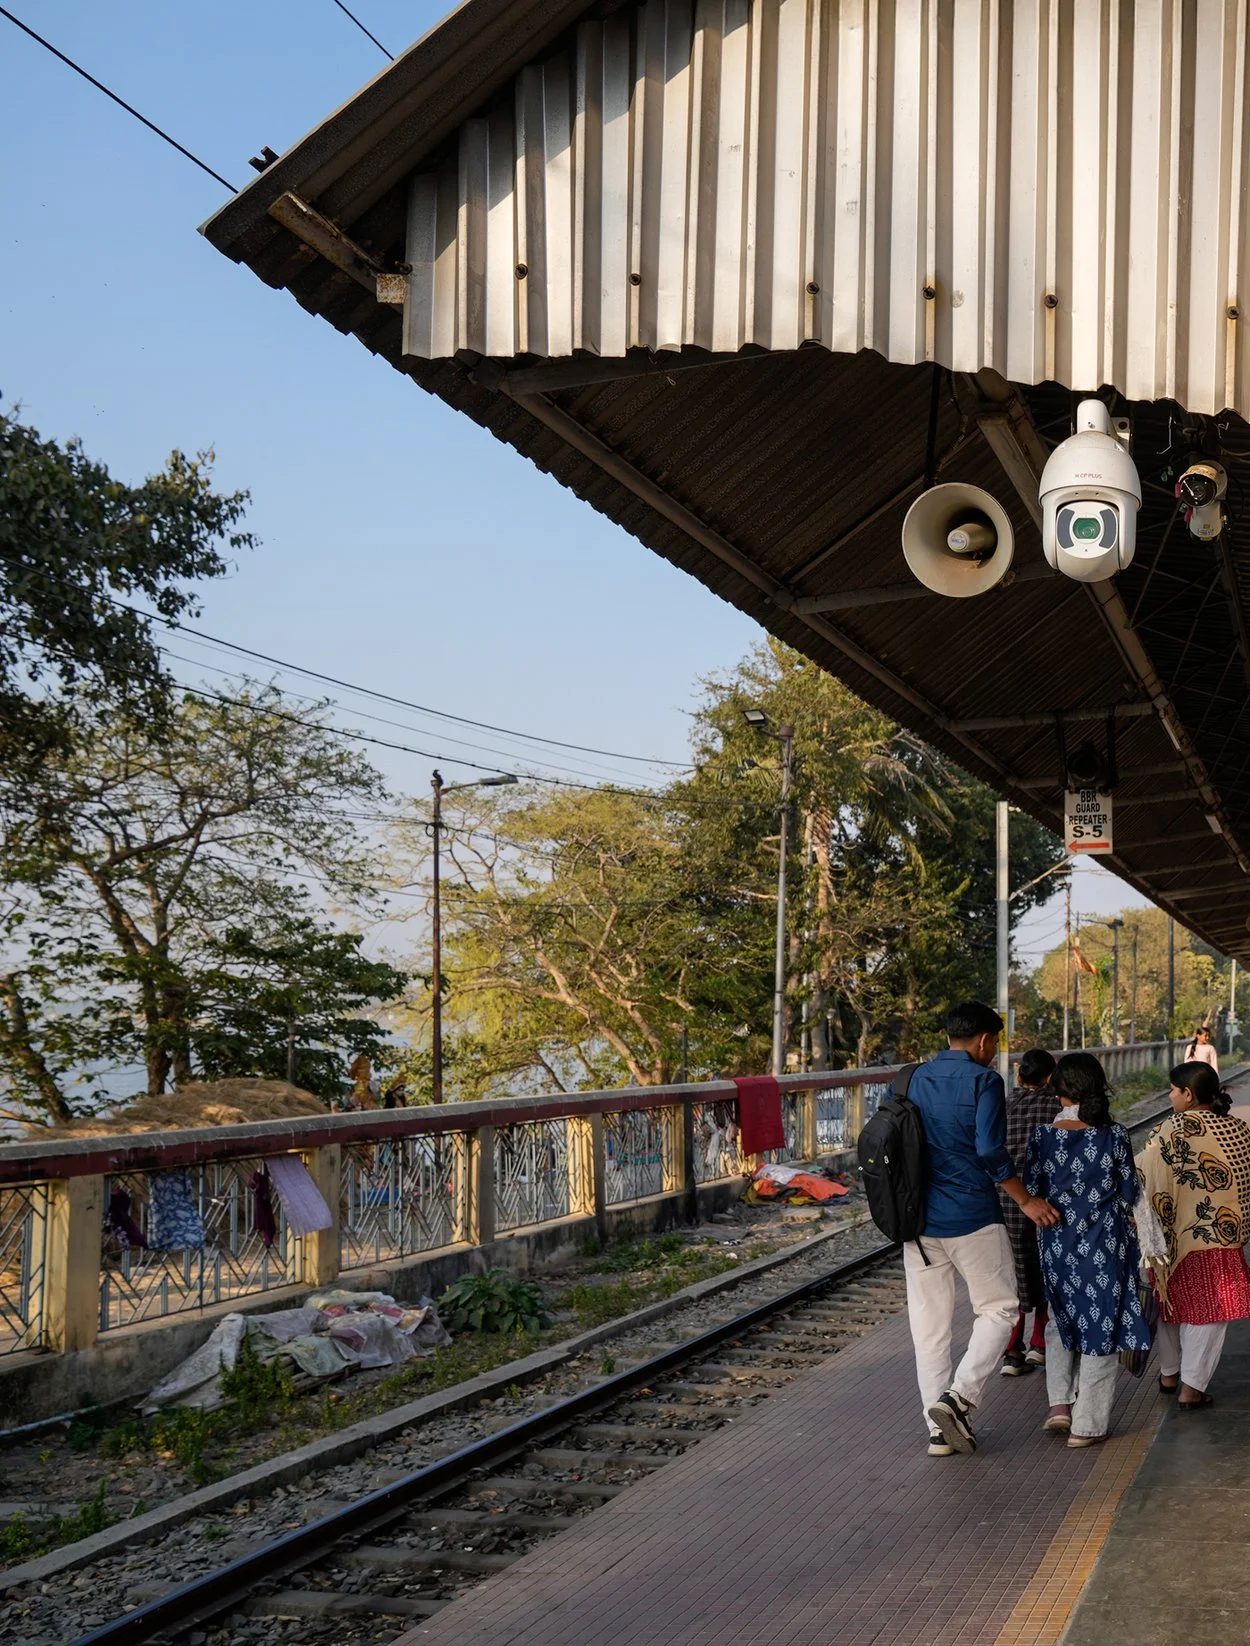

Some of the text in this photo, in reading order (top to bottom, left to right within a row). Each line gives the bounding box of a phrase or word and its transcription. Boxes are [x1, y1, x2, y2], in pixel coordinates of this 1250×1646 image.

[1080, 790, 1097, 802] BBR
[1076, 803, 1100, 813] GUARD
[1069, 814, 1107, 825] REPEATER
[1072, 825, 1103, 838] S-5
